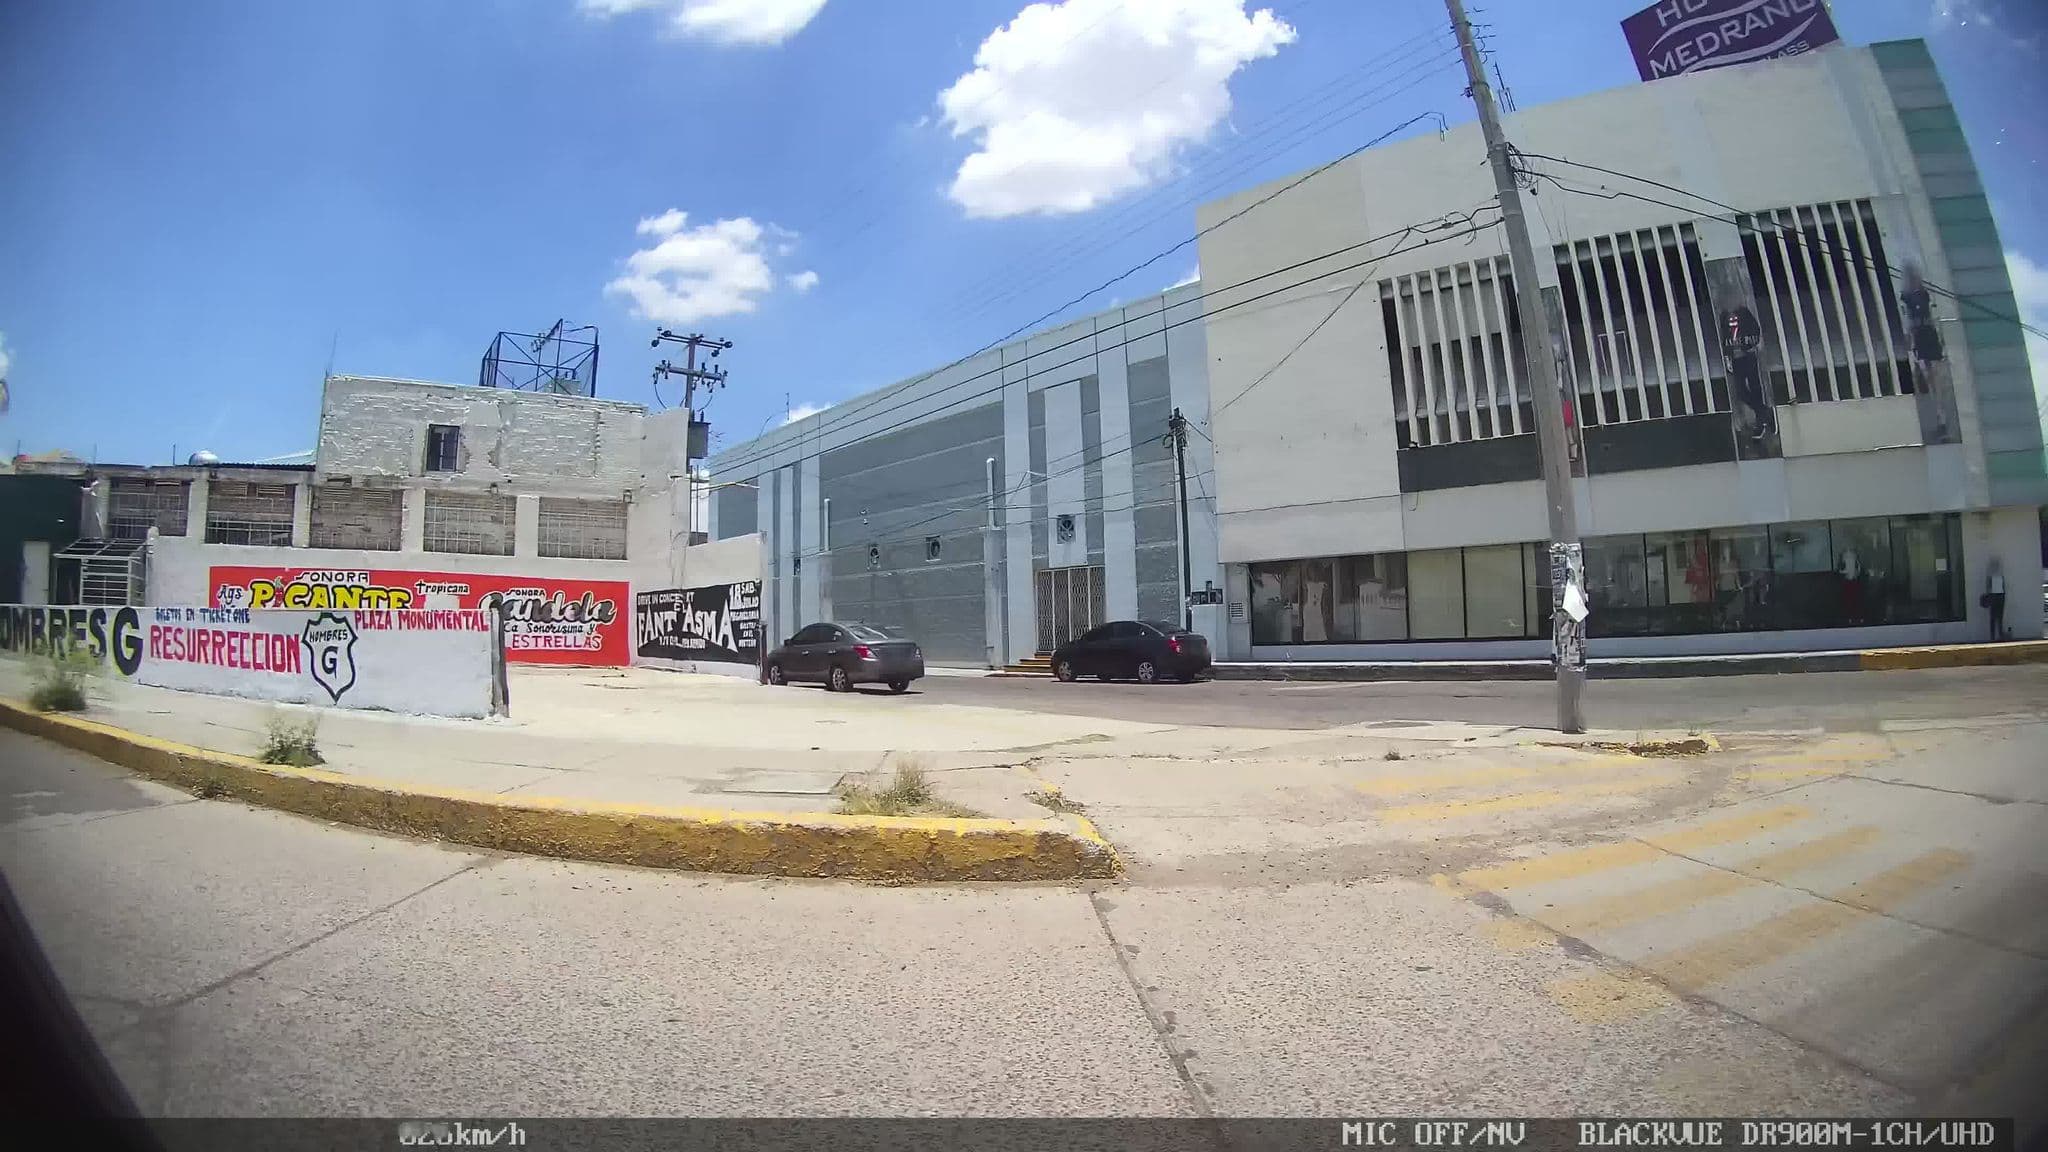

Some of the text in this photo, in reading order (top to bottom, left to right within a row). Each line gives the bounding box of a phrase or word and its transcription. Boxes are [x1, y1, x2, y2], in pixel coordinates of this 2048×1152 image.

[296, 571, 368, 583] SONORA
[506, 588, 545, 597] SONORA
[355, 611, 489, 632] PLAZA MONUMENTAL
[638, 599, 739, 653] FANTASMA
[113, 606, 144, 676] G
[150, 624, 301, 674] RESURRECCION
[512, 634, 601, 649] ESTRELLAS
[321, 645, 339, 679] G
